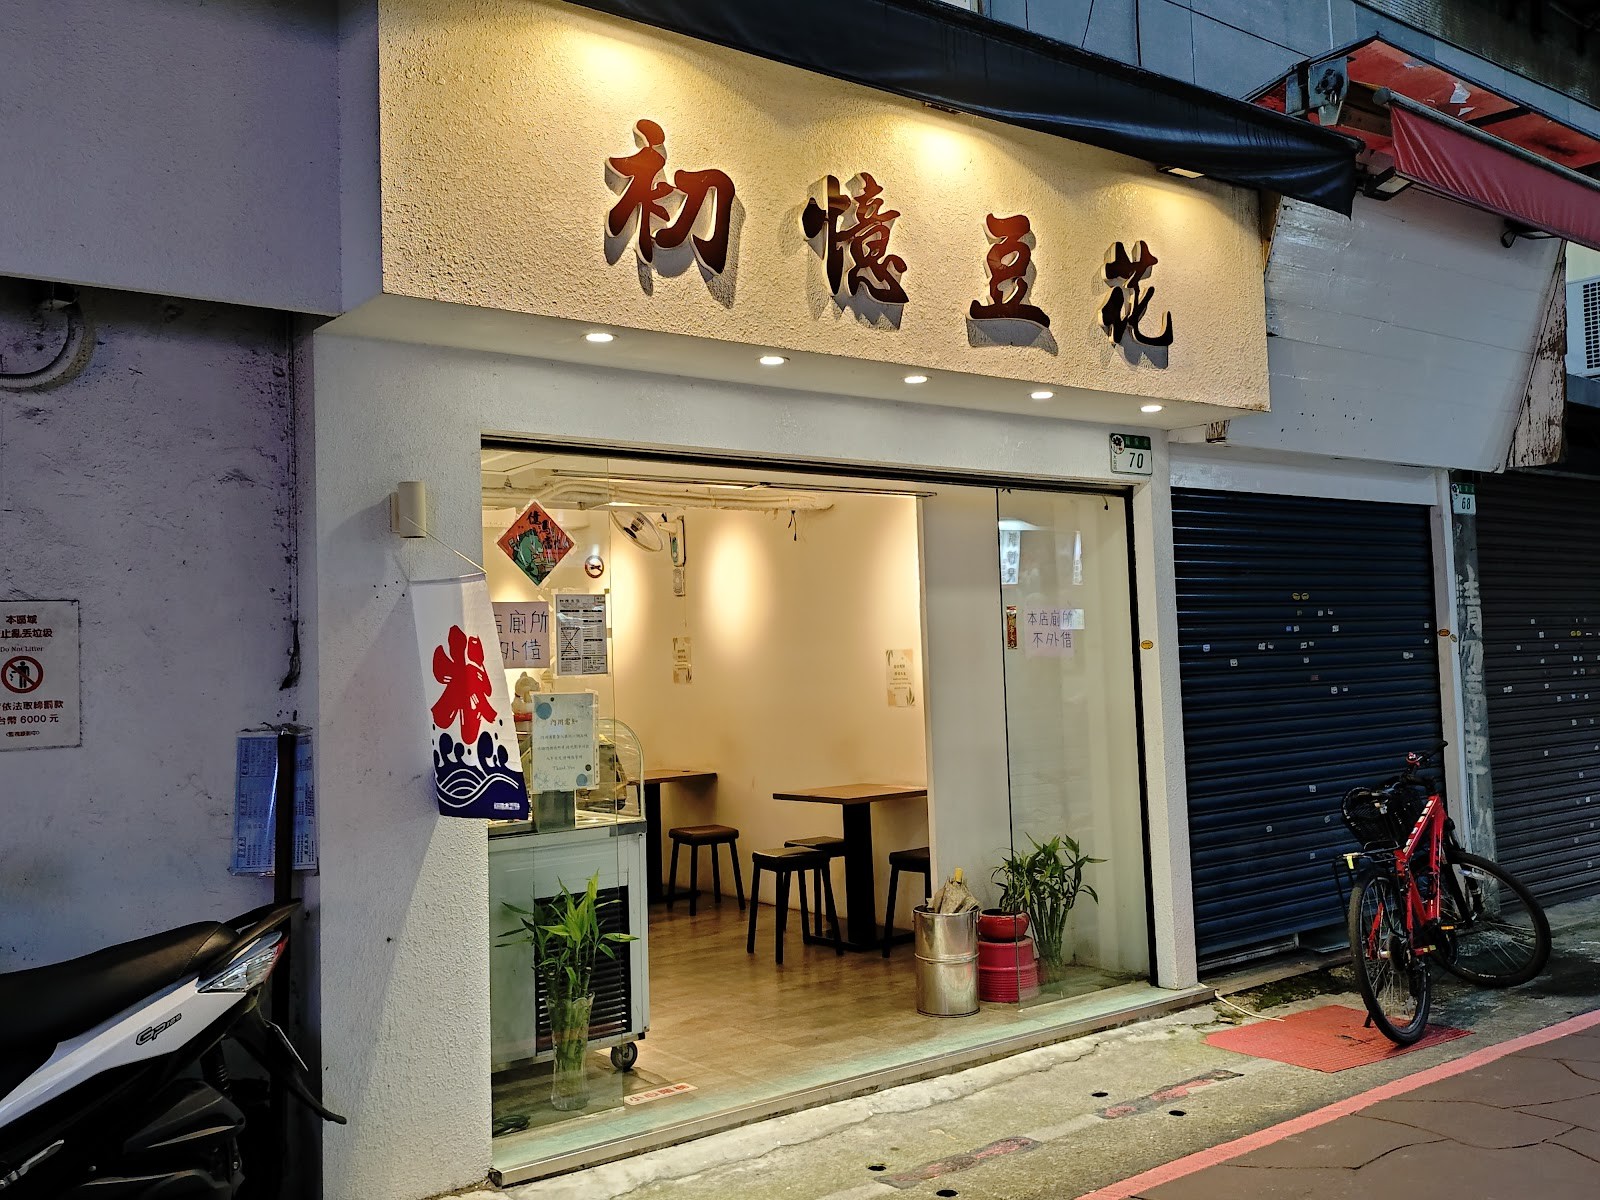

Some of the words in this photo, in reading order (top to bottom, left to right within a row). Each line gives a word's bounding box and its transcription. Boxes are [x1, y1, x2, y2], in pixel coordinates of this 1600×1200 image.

[604, 118, 1174, 346] 初憶豆花
[1129, 452, 1144, 469] 70
[1461, 497, 1471, 510] 68
[5, 614, 38, 625] 本區域
[1027, 610, 1073, 627] 本店廁所
[1033, 631, 1072, 648] 不外借
[0, 699, 64, 711] 依法取締罰款
[20, 715, 47, 724] 6000
[49, 713, 59, 723] 元
